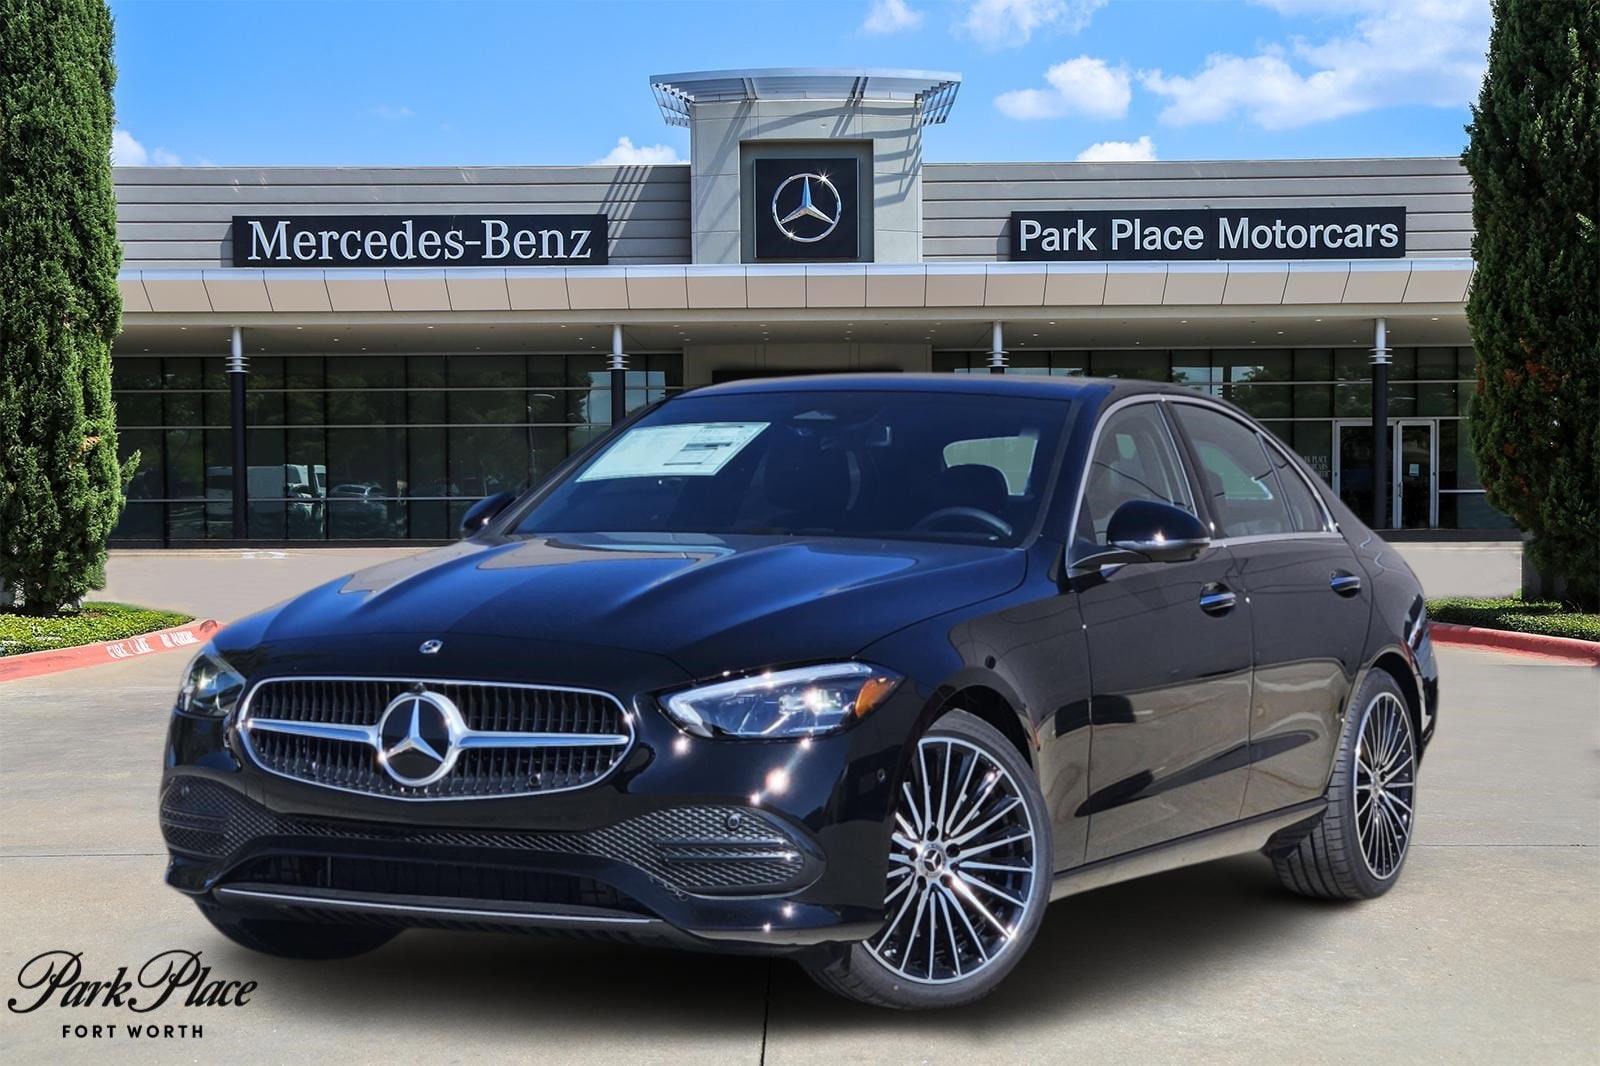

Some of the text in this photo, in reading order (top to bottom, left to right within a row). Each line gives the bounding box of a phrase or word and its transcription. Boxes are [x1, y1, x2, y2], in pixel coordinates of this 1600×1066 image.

[247, 219, 592, 261] Mercedes-Benz
[1020, 216, 1399, 252] Park Place Motorcars
